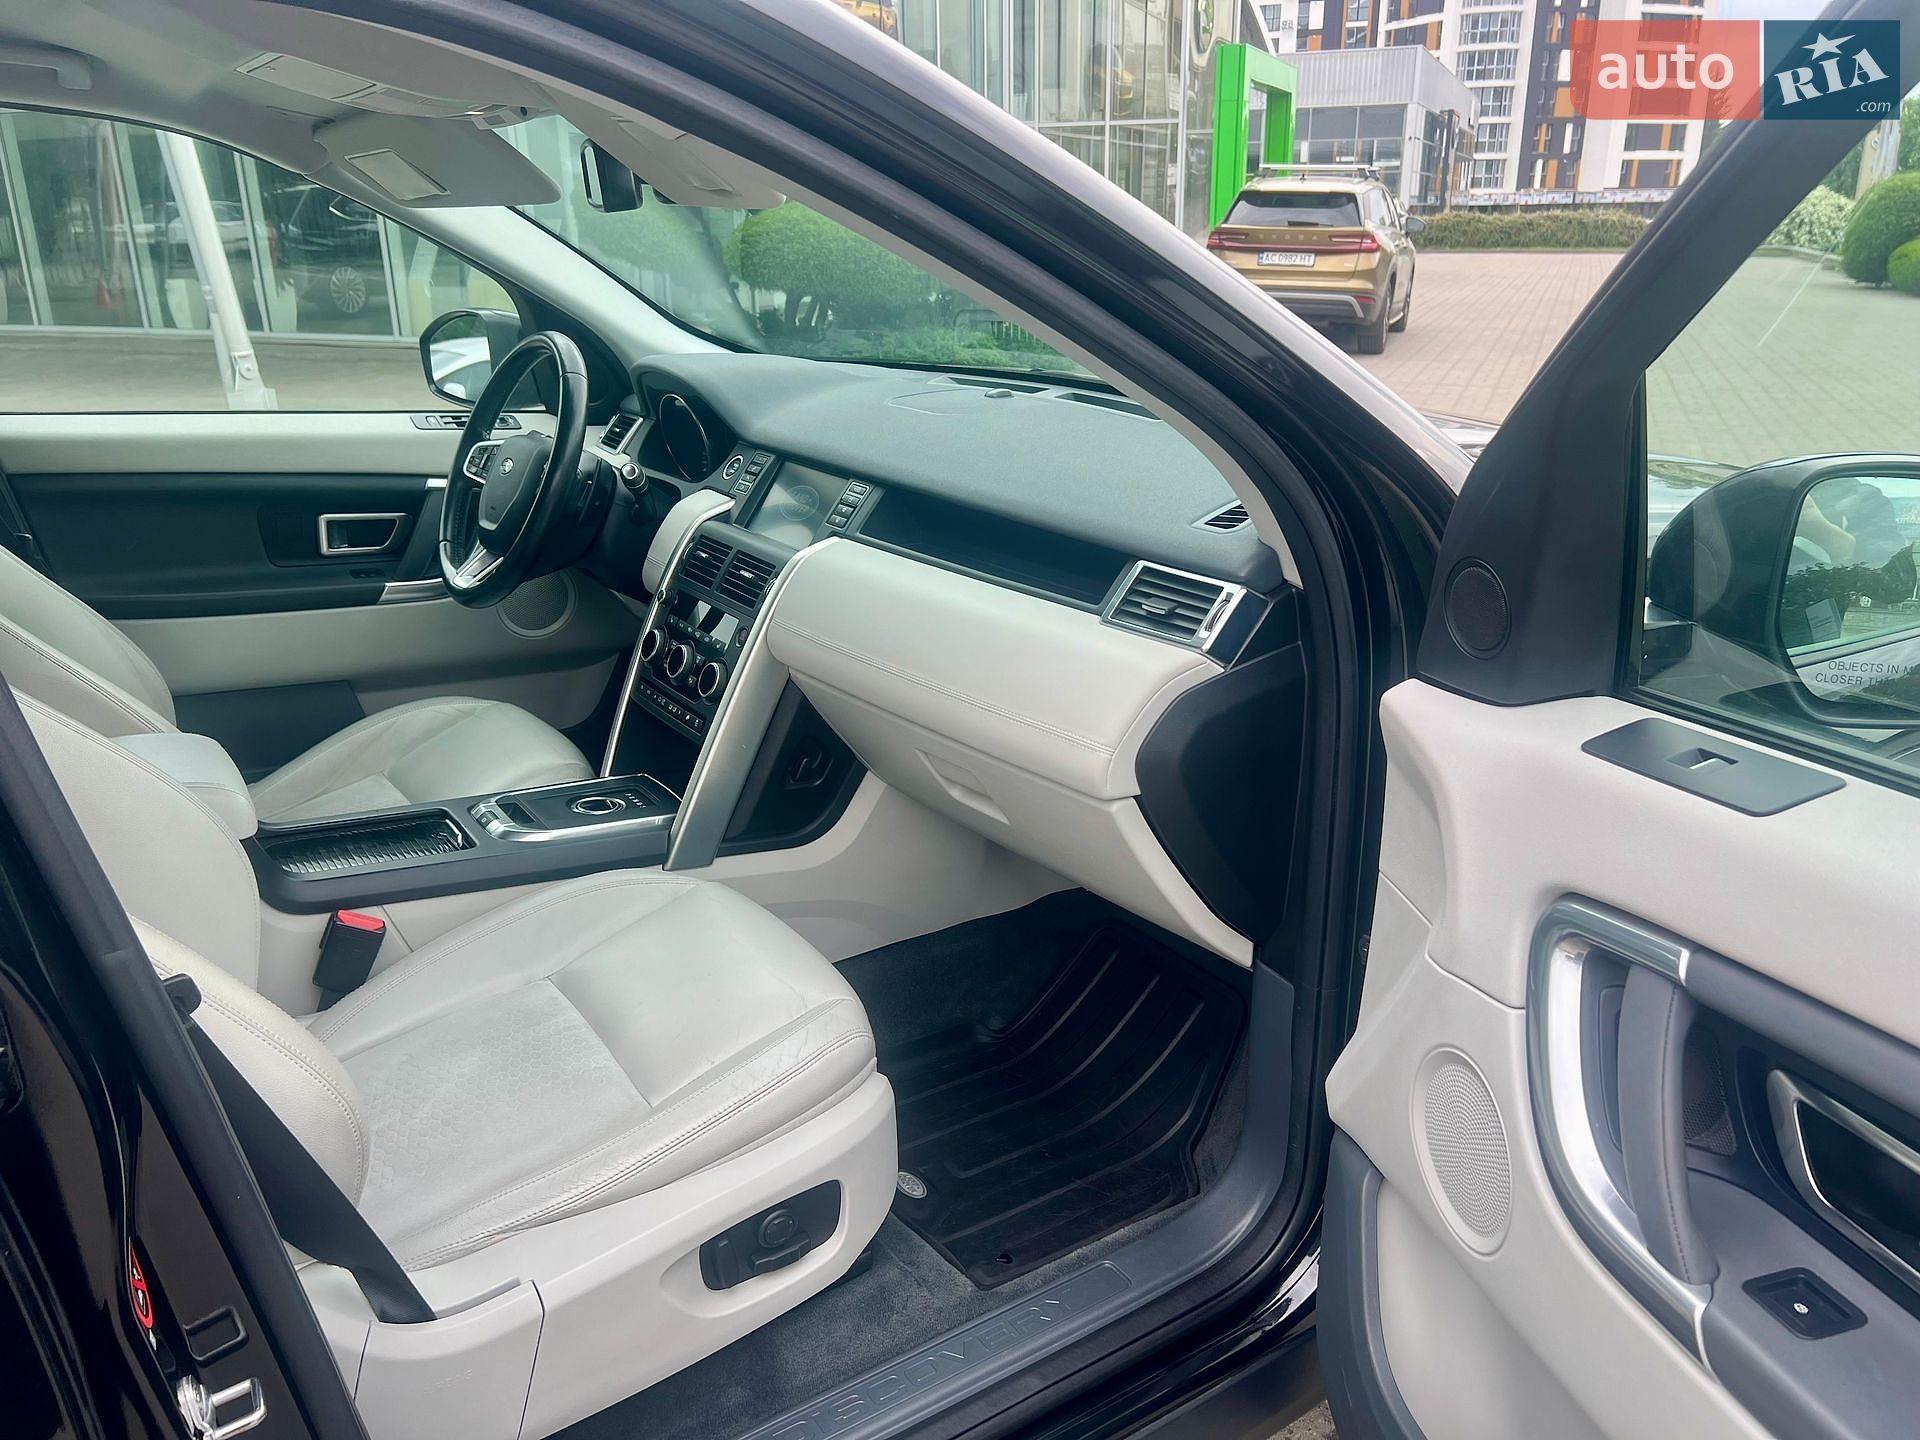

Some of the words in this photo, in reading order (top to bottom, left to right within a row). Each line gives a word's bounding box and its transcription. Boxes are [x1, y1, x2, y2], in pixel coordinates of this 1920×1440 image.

[1828, 661, 1884, 673] OBJECTS
[1887, 665, 1900, 674] IN
[1815, 672, 1863, 685] CLOSER
